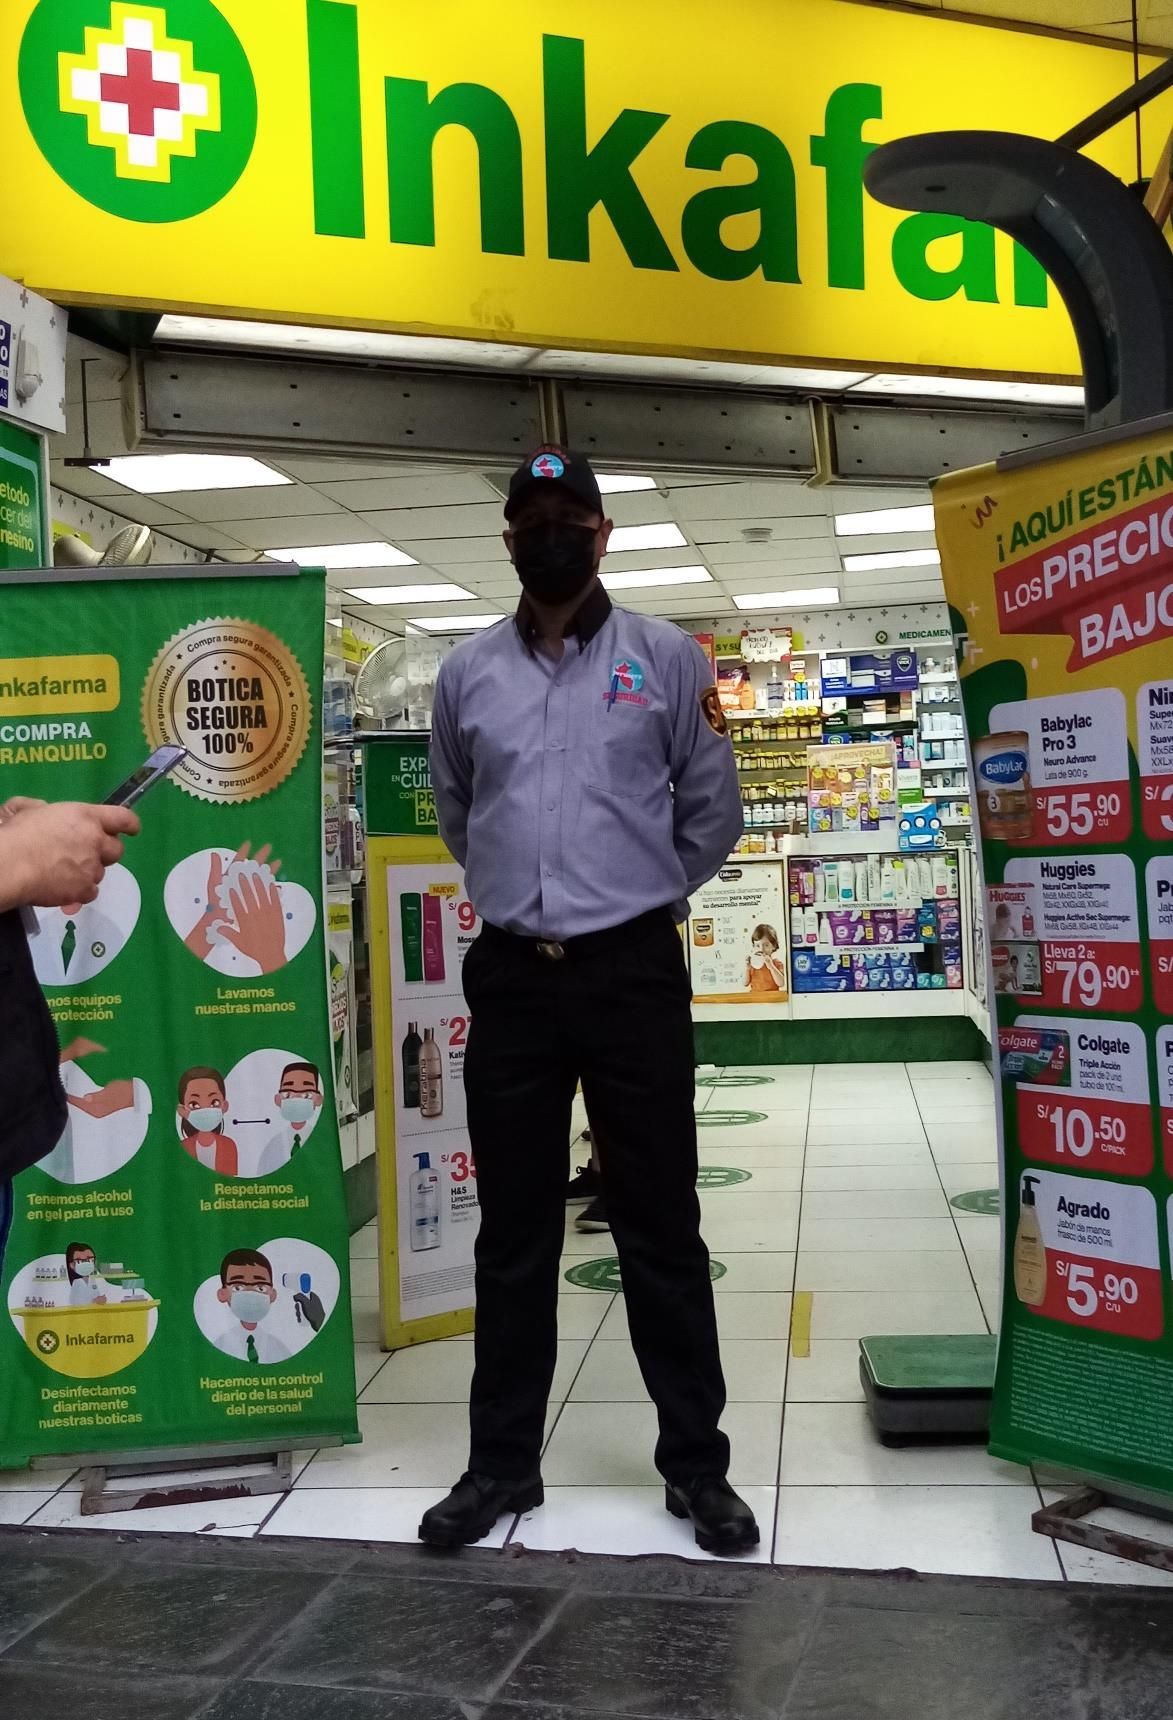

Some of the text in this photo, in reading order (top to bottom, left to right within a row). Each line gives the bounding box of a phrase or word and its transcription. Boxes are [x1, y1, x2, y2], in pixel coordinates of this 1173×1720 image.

[1004, 577, 1043, 613] LOS
[187, 634, 292, 688] Compra segura garantizada
[157, 664, 176, 720] garantizada
[187, 677, 265, 702] BOTICA
[186, 705, 269, 731] SEGURA
[1041, 714, 1093, 733] Babylac
[0, 721, 92, 743] COMPRA
[202, 732, 254, 755] 100%
[218, 703, 299, 789] Compra segura garantizada
[1042, 734, 1077, 752] Pro 3
[1066, 754, 1097, 765] Advance
[1068, 768, 1081, 778] 900
[1040, 861, 1096, 880] Huggies
[458, 901, 476, 931] 9
[1044, 944, 1076, 960] Lleva
[1078, 944, 1086, 959] 2
[72, 993, 122, 1008] equipos
[216, 987, 275, 999] Lavamos
[195, 1001, 297, 1015] nuestras manos
[998, 1034, 1038, 1049] olgate
[1078, 1034, 1130, 1055] Colgate
[1058, 1045, 1065, 1058] 2
[1079, 1058, 1121, 1070] Triple Acción
[26, 1189, 133, 1205] Tenemos alcohol
[214, 1183, 294, 1197] Respetamos
[450, 1186, 467, 1195] H&S
[200, 1195, 310, 1211] la distancia social
[451, 1194, 476, 1203] Limpieza
[27, 1205, 134, 1222] en gel para tu uso
[1057, 1195, 1110, 1220] Agrado
[1087, 1234, 1104, 1246] 500
[65, 1333, 135, 1346] Inkafarma
[200, 1372, 323, 1389] Hacemos un control
[41, 1384, 137, 1400] Desinfectamos
[211, 1386, 313, 1403] diario de la salud
[53, 1399, 129, 1413] diariamente
[226, 1401, 302, 1417] del personal
[39, 1412, 143, 1429] nuestras boticas
